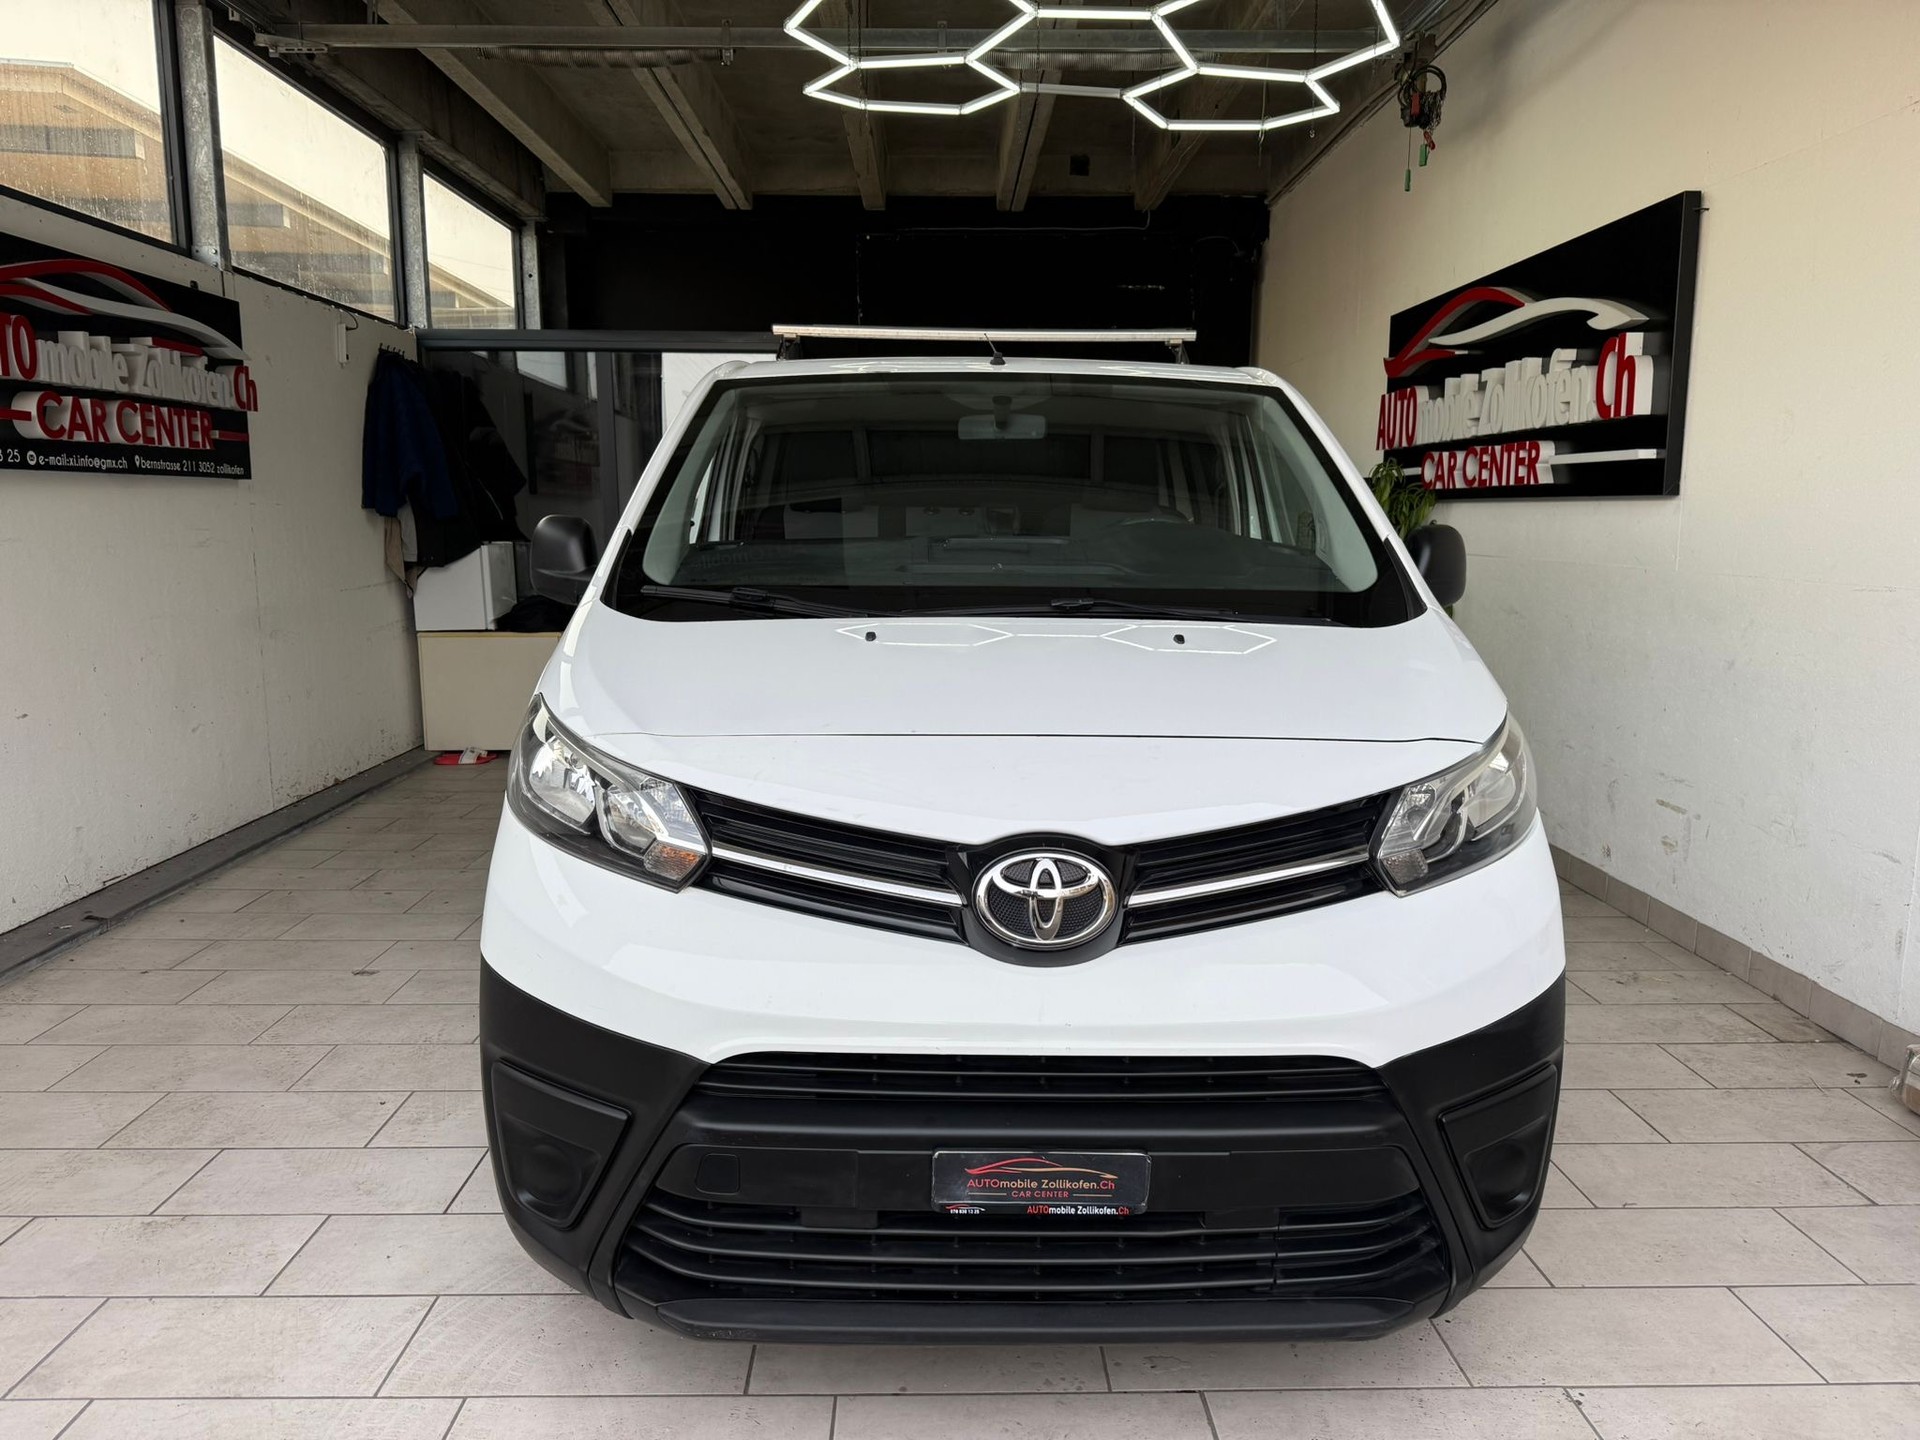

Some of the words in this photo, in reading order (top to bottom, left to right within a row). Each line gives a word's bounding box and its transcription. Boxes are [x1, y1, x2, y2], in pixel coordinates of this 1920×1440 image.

[37, 391, 110, 443] CAR
[116, 401, 214, 450] CENTER
[7, 449, 21, 463] 25
[141, 457, 181, 471] bernstrasse
[183, 460, 196, 472] 211
[1421, 451, 1458, 490] CAR
[1462, 440, 1541, 487] CENTER
[967, 1179, 1038, 1189] AUTOmobile
[1041, 1179, 1115, 1190] Zollikofen.Ch
[1011, 1190, 1031, 1198] CAR
[1034, 1190, 1069, 1198] CENTER
[1027, 1205, 1075, 1214] AUTOmobile
[1077, 1206, 1130, 1215] Zollikofen.Ch
